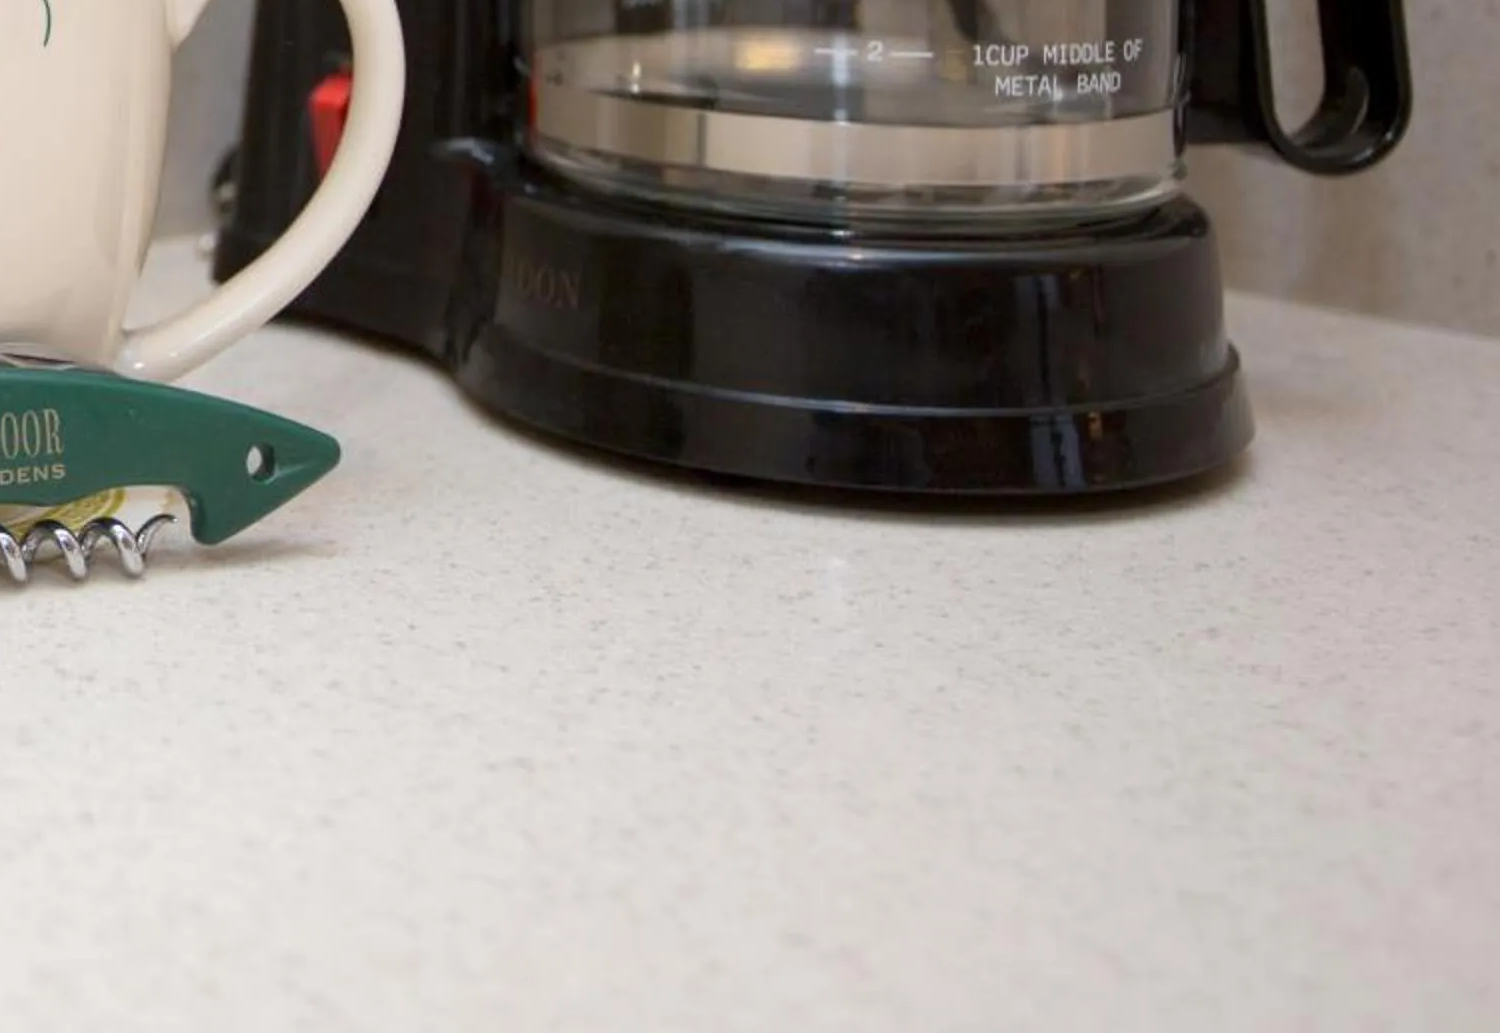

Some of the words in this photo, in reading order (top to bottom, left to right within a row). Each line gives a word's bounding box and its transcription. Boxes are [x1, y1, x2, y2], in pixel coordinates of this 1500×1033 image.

[867, 40, 884, 62] 2
[1043, 41, 1115, 65] MIDDLE
[1122, 38, 1144, 62] OF
[995, 74, 1059, 98] METAL
[1077, 72, 1122, 94] BAND
